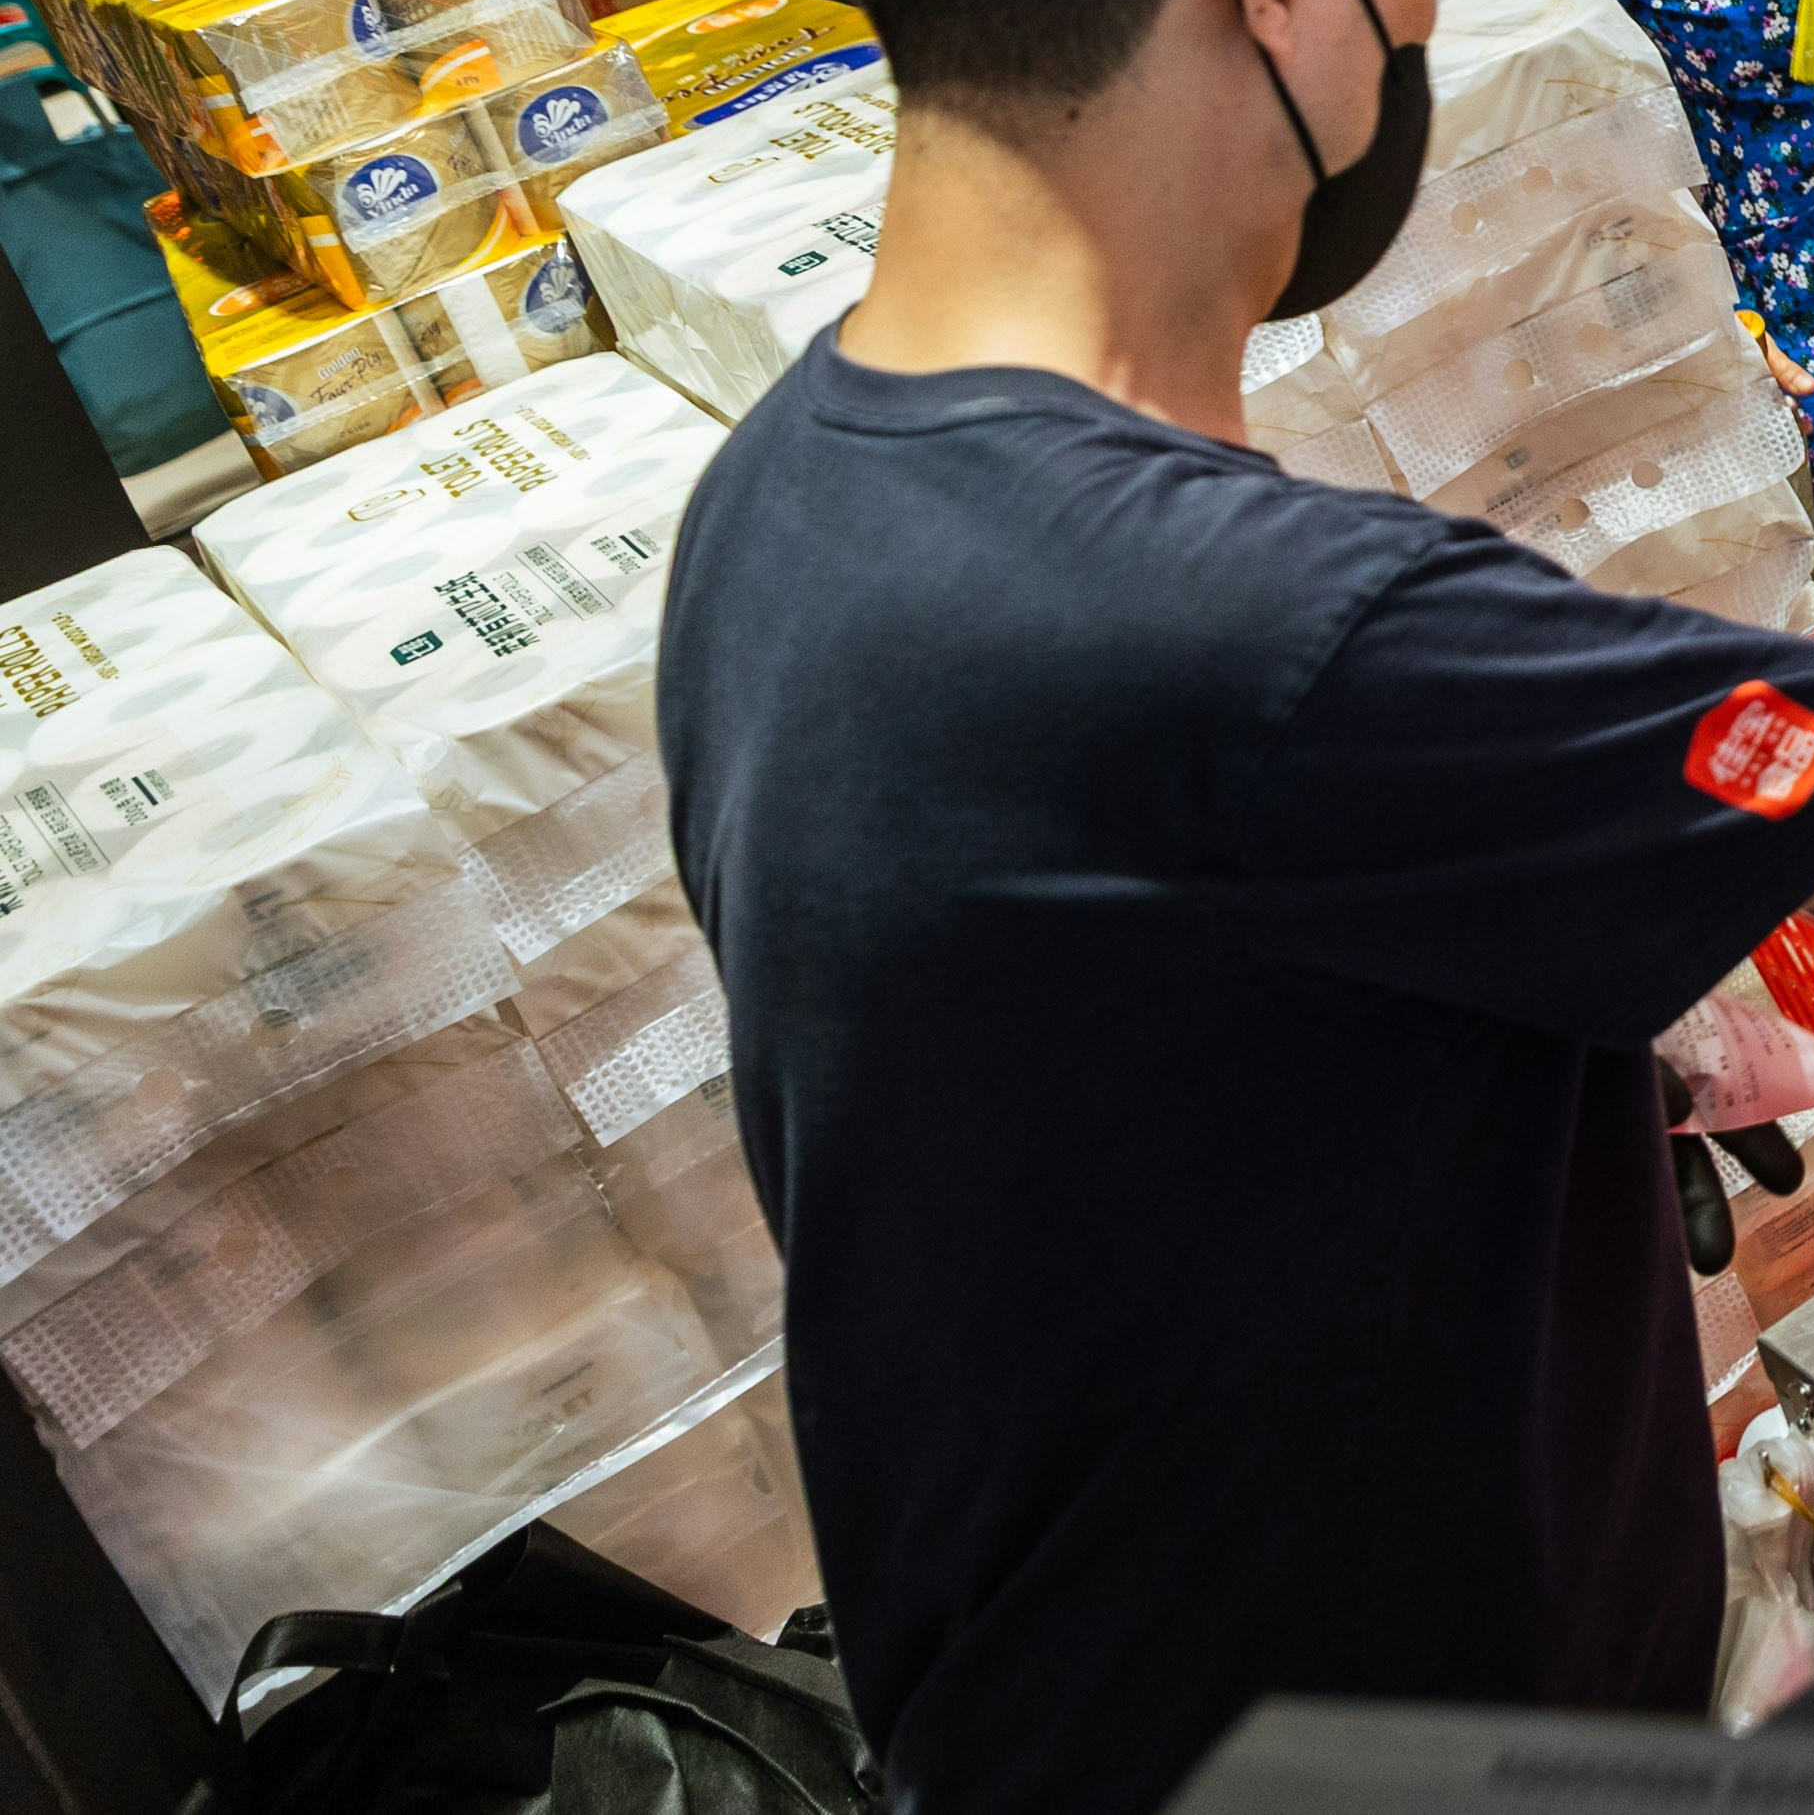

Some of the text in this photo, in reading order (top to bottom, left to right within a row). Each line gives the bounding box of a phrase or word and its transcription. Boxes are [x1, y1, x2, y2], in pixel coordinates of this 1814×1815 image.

[541, 111, 593, 150] Vinda
[365, 181, 420, 222] Vinda
[316, 345, 362, 381] Golden
[419, 452, 489, 498] TOILET
[453, 418, 559, 493] PAPER ROLLS
[11, 663, 82, 719] PAPER
